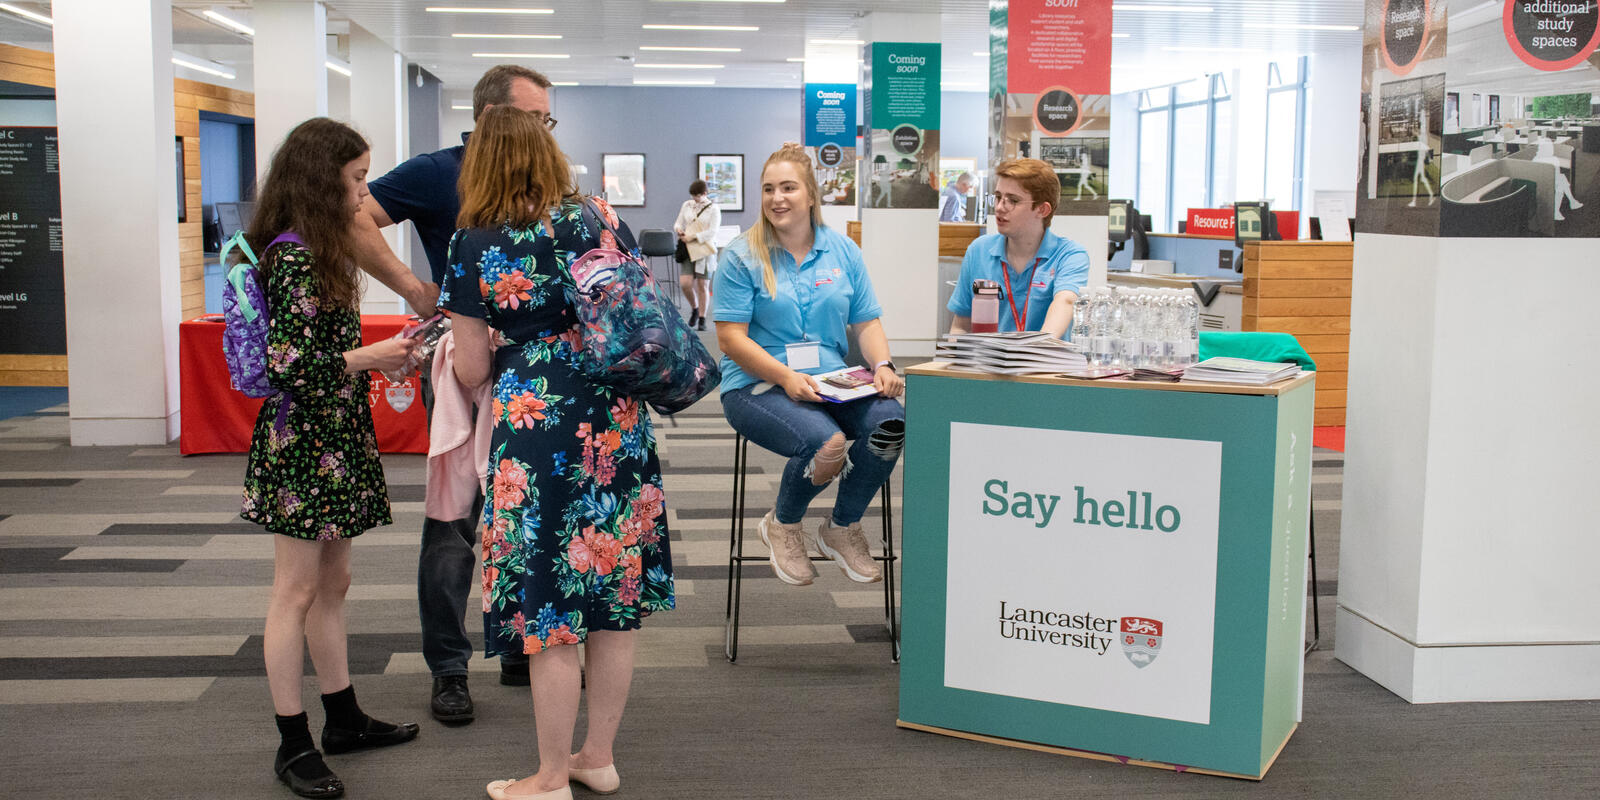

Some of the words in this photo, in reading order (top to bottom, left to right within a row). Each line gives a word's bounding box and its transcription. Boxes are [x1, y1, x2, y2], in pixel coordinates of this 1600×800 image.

[1523, 0, 1590, 14] additional
[1391, 7, 1420, 23] Research
[1537, 17, 1575, 33] study
[1395, 26, 1414, 40] space
[1532, 36, 1577, 49] spaces
[888, 54, 926, 66] Coming
[896, 65, 919, 73] soon
[817, 90, 846, 100] Coming
[1043, 104, 1073, 112] Research
[8, 131, 15, 139] C
[12, 212, 18, 221] B
[1193, 214, 1229, 229] Resource
[15, 293, 27, 301] LG
[982, 479, 1061, 528] Say
[1073, 486, 1181, 533] hello
[999, 600, 1118, 633] Lancaster
[999, 620, 1112, 656] University
